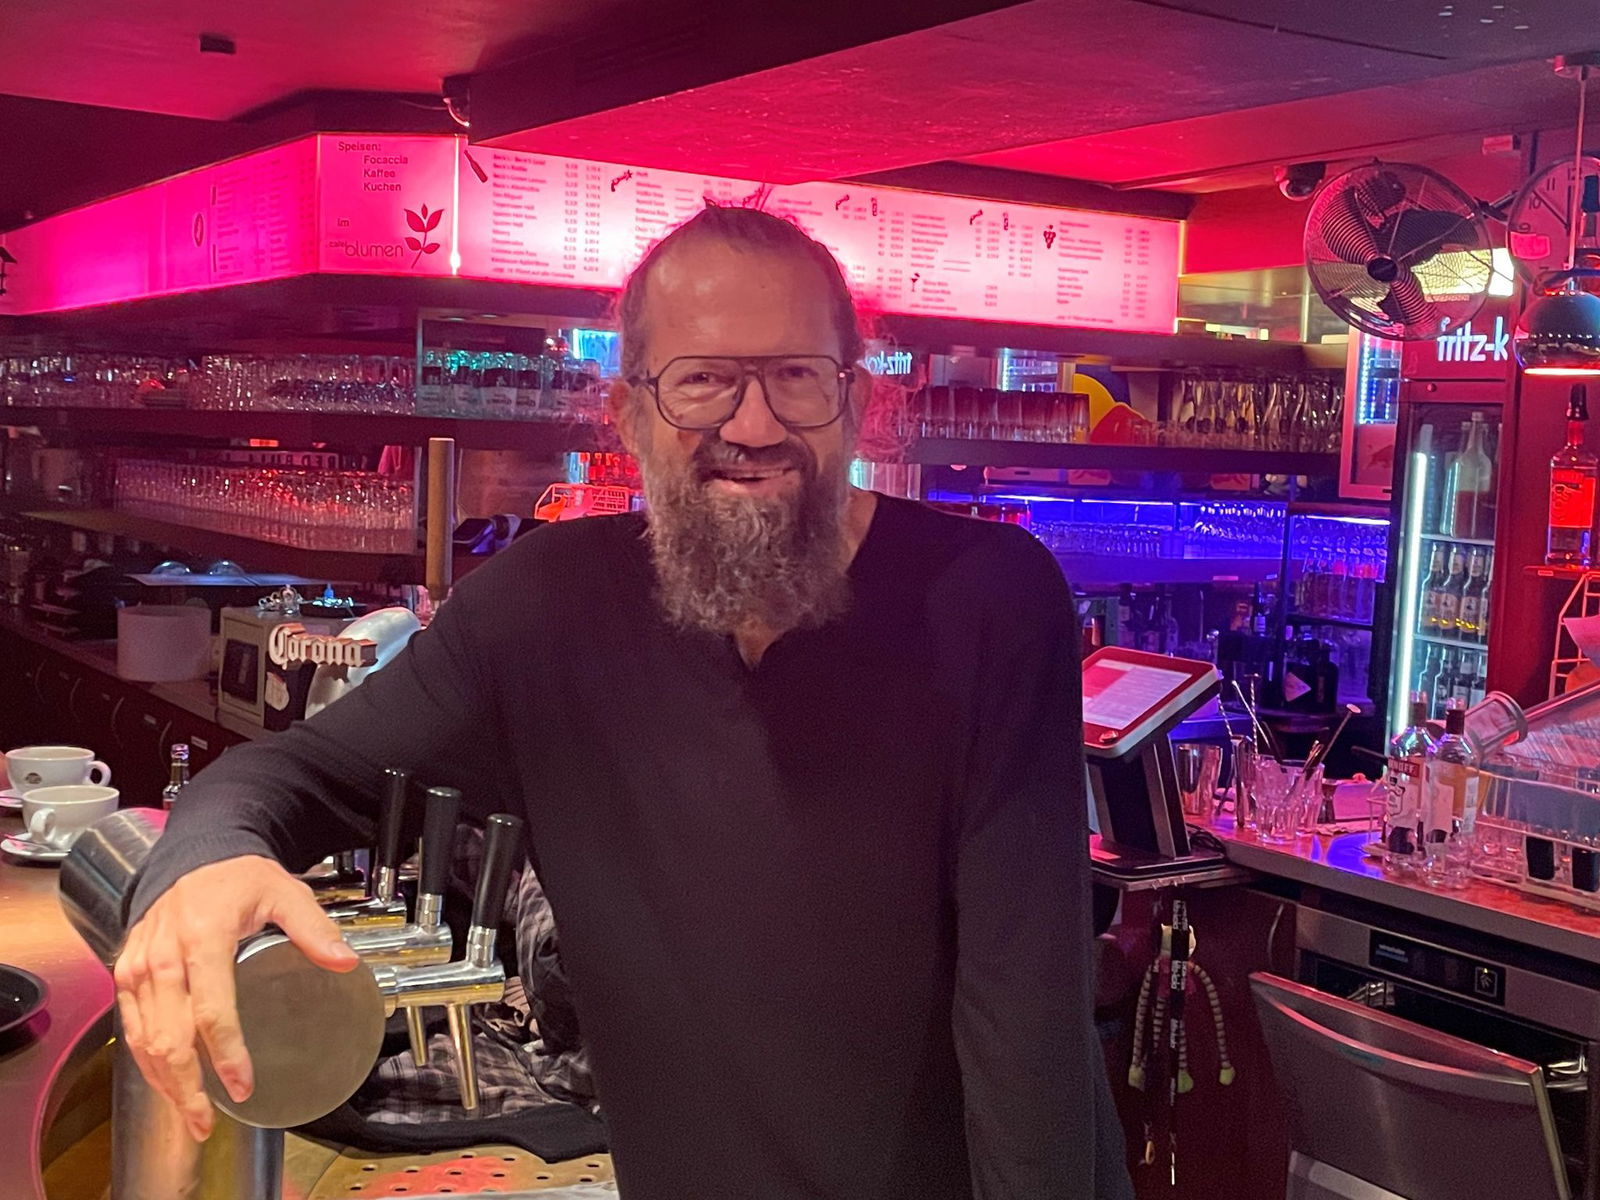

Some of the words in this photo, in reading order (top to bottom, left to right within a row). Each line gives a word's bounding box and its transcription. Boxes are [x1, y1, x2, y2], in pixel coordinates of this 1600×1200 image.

[338, 141, 382, 152] Speisen:
[363, 155, 408, 164] Focaccia
[363, 168, 396, 178] Kaffee
[363, 182, 402, 192] Kuchen
[344, 240, 404, 257] blumen
[1436, 316, 1510, 362] fritz-k
[268, 623, 366, 670] Corona
